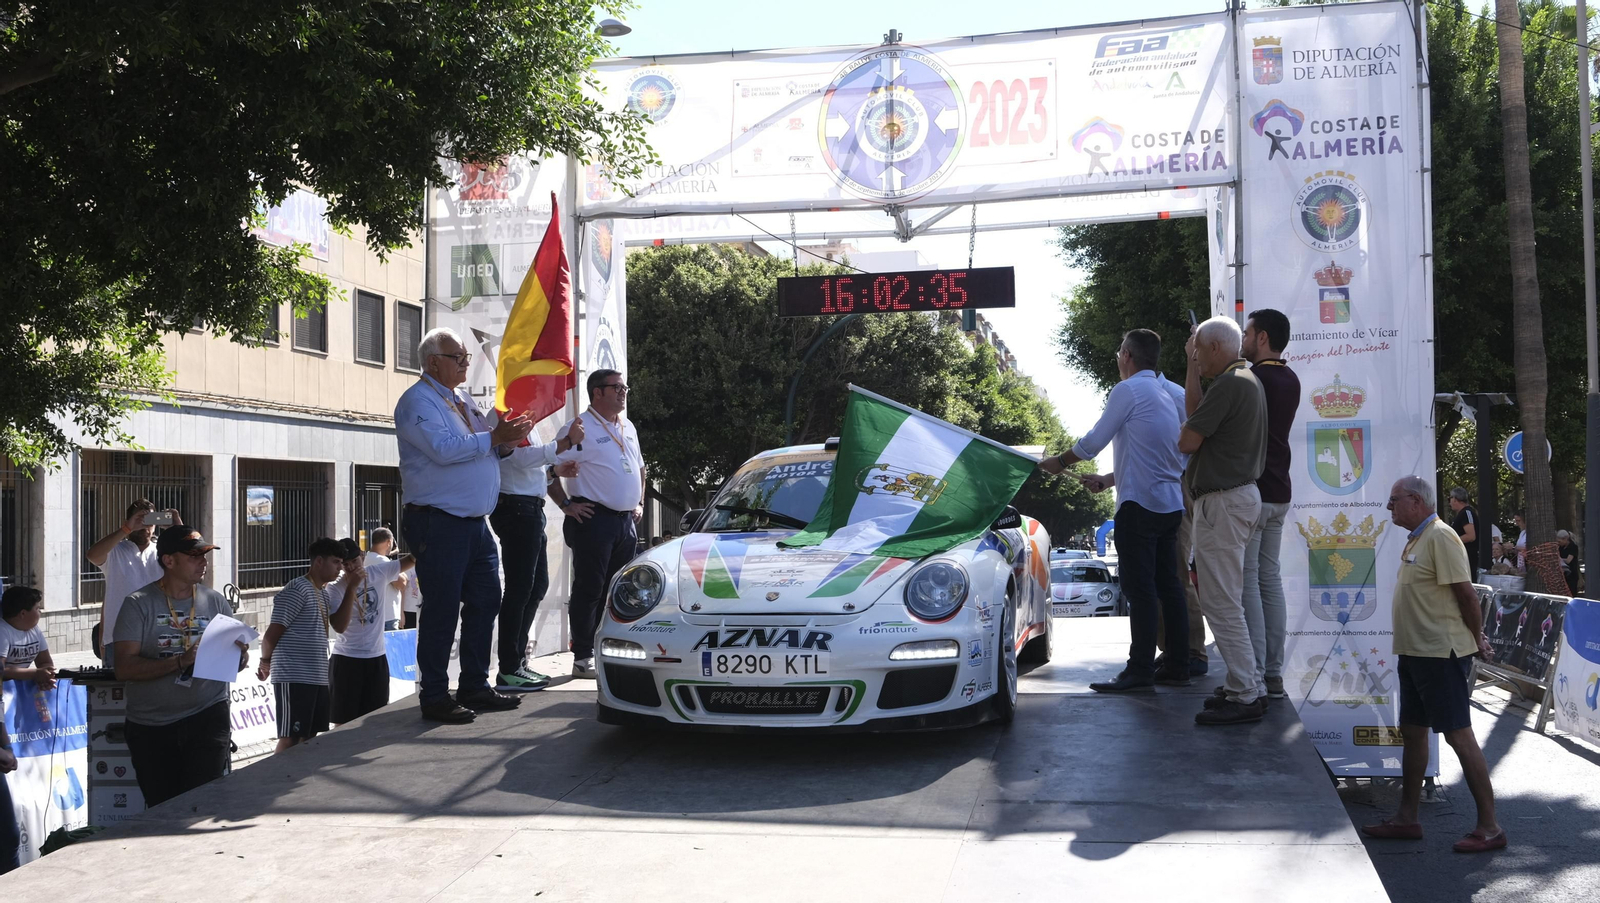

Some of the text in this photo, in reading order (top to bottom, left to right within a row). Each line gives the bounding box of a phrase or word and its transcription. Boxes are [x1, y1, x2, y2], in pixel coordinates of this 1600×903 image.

[849, 55, 872, 71] RALLYE
[875, 51, 898, 59] COSTA
[1091, 51, 1198, 68] federación andaluza
[1292, 43, 1401, 64] DIPUTACIÓN
[1106, 59, 1197, 74] automovilismo
[1293, 59, 1397, 81] DE ALMERÍA
[624, 69, 682, 92] AUTOMOVIL CLUB
[861, 93, 924, 120] AUTOMOVIL CLUB
[969, 76, 1048, 149] 2023
[1310, 115, 1400, 135] COSTA DE
[1131, 129, 1224, 149] COSTA DE
[1292, 131, 1404, 160] ALMERÍA
[872, 150, 911, 159] ALMERIA
[1112, 145, 1228, 177] ALMERÍA
[648, 176, 718, 195] ALMERÍA
[849, 180, 857, 188] de
[928, 170, 943, 183] 2023
[1296, 178, 1367, 207] AUTOMOVIL CLUB
[1311, 239, 1354, 250] ALMERIA
[457, 263, 494, 278] UNED
[820, 272, 968, 313] 16:02:35
[1289, 326, 1399, 342] untamiento de Vícar
[1282, 341, 1391, 365] Corazón del Poniente
[764, 470, 817, 481] MOTOR
[1292, 501, 1339, 510] Ayuntamiento
[1349, 500, 1383, 509] Alboloduy
[690, 627, 835, 653] AZNAR
[704, 667, 710, 675] E
[716, 654, 827, 674] 8290 KTL
[709, 690, 821, 706] PRORALLYE
